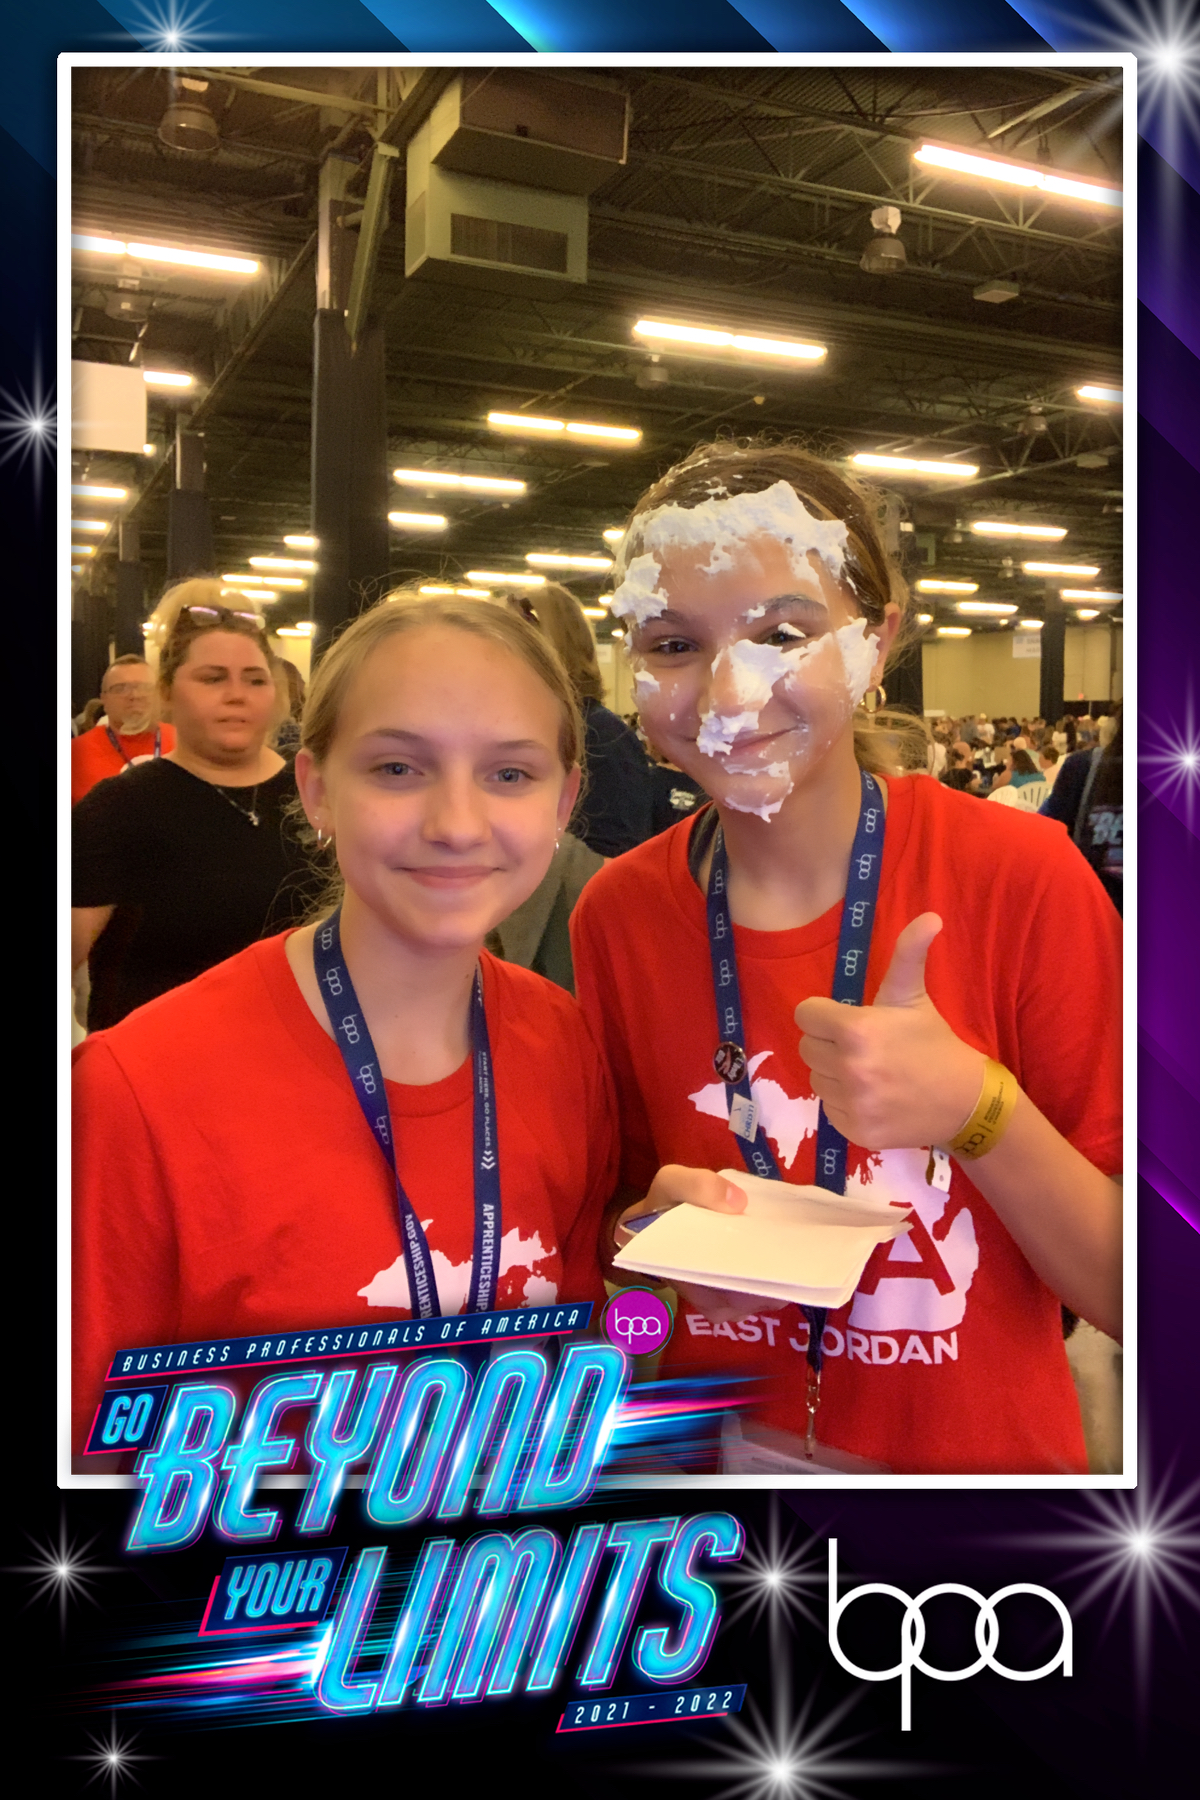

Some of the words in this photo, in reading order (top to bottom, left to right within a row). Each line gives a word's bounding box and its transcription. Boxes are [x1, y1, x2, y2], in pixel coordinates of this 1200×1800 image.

[864, 808, 880, 833] bpa
[856, 854, 877, 880] bpa
[713, 913, 728, 940] bpa
[848, 901, 870, 928] bpa
[718, 959, 734, 987] bpa
[841, 949, 863, 977] bpa
[322, 966, 343, 996] bpa
[338, 1013, 360, 1044] bpa
[723, 1006, 739, 1035] bpa
[355, 1063, 376, 1095] bpa
[374, 1115, 390, 1145] bpa
[820, 1148, 841, 1175] bpa
[685, 1313, 780, 1347] EAST
[789, 1322, 959, 1365] JORDAN
